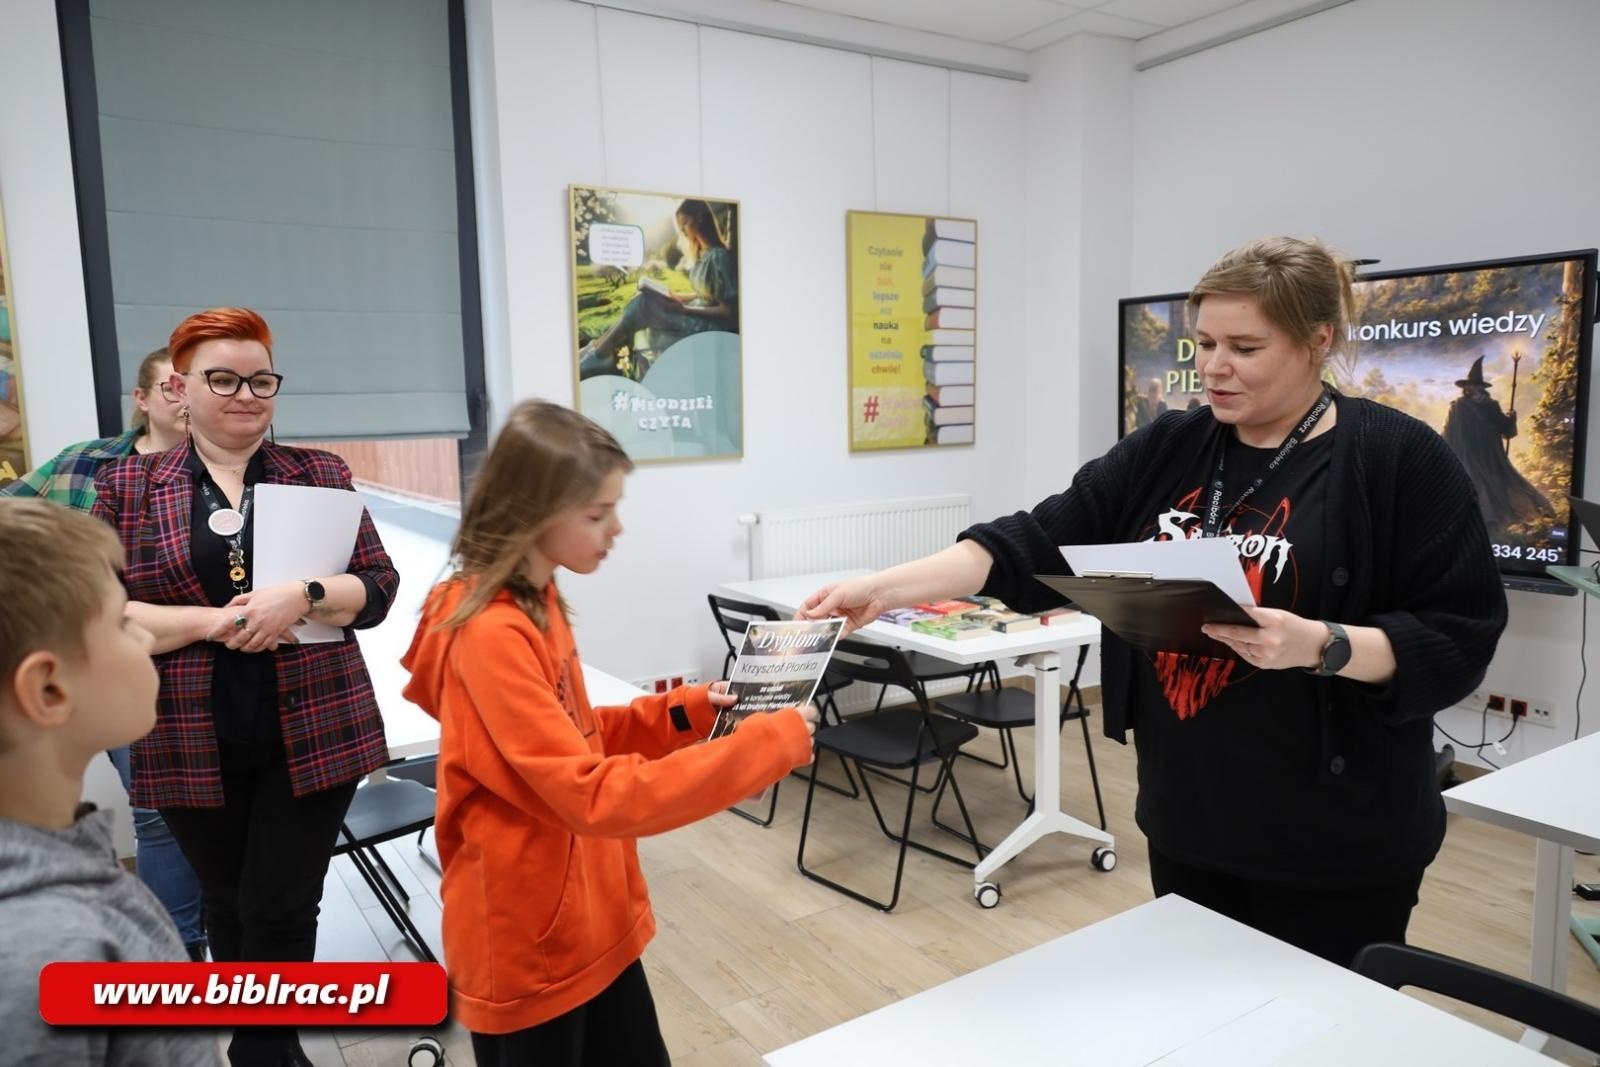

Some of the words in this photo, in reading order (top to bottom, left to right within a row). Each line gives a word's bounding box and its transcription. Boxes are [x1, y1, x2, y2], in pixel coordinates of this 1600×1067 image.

[868, 245, 904, 258] Czytanie
[873, 320, 899, 330] nauka
[1348, 318, 1441, 341] konkurs
[1449, 311, 1546, 338] wiedzy
[638, 414, 692, 430] CZYTA
[1298, 402, 1327, 433] Racibórz
[1207, 489, 1223, 525] Racibórz
[1491, 544, 1522, 559] 334
[758, 630, 821, 653] Dyplom
[741, 662, 785, 677] Krzysztof
